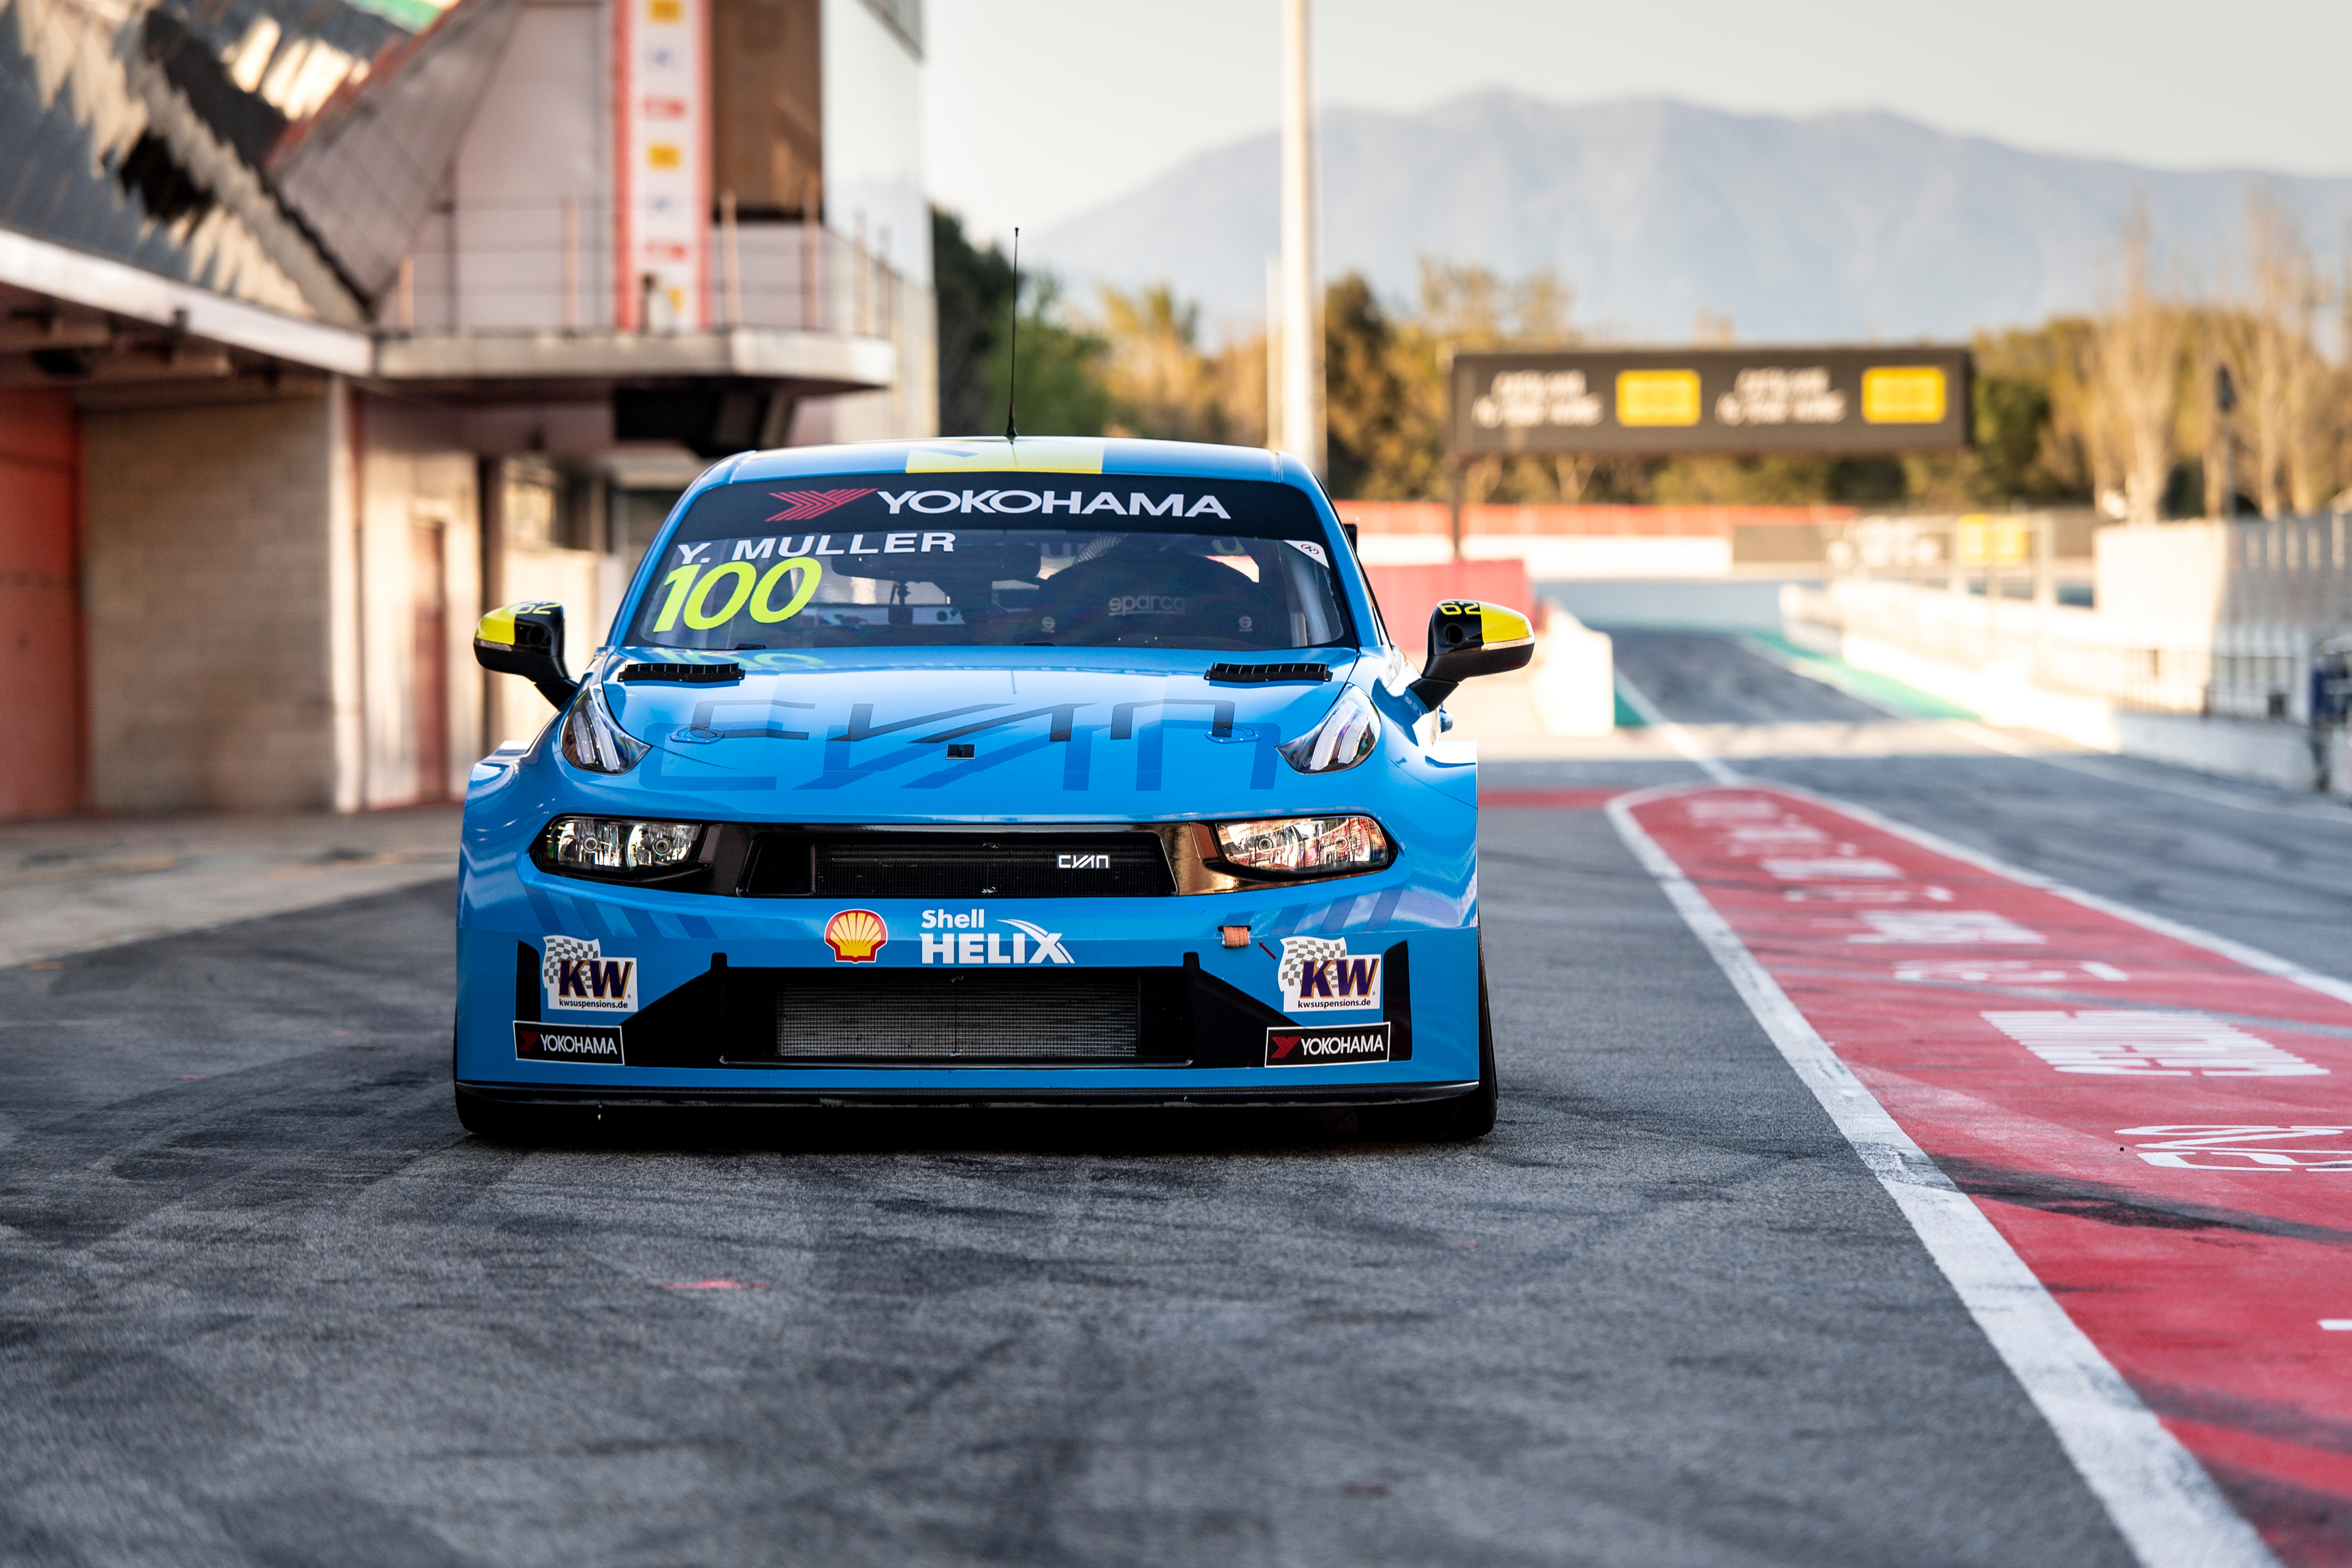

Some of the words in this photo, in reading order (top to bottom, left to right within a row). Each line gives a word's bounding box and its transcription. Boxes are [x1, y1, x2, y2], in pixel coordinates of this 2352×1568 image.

[877, 489, 1231, 519] YOKOHAMA
[677, 543, 711, 565] Y.
[731, 532, 956, 561] MULLER
[653, 557, 822, 633] 100
[921, 909, 985, 928] Shell
[920, 932, 1075, 964] HELIX
[559, 958, 633, 999] KW
[1299, 958, 1379, 998] KW
[559, 998, 628, 1009] kwsuspensions.de
[1298, 998, 1371, 1009] kwsuspensions.de
[540, 1034, 617, 1054] YOKOHAMA
[1301, 1034, 1384, 1055] YOKOHAMA
